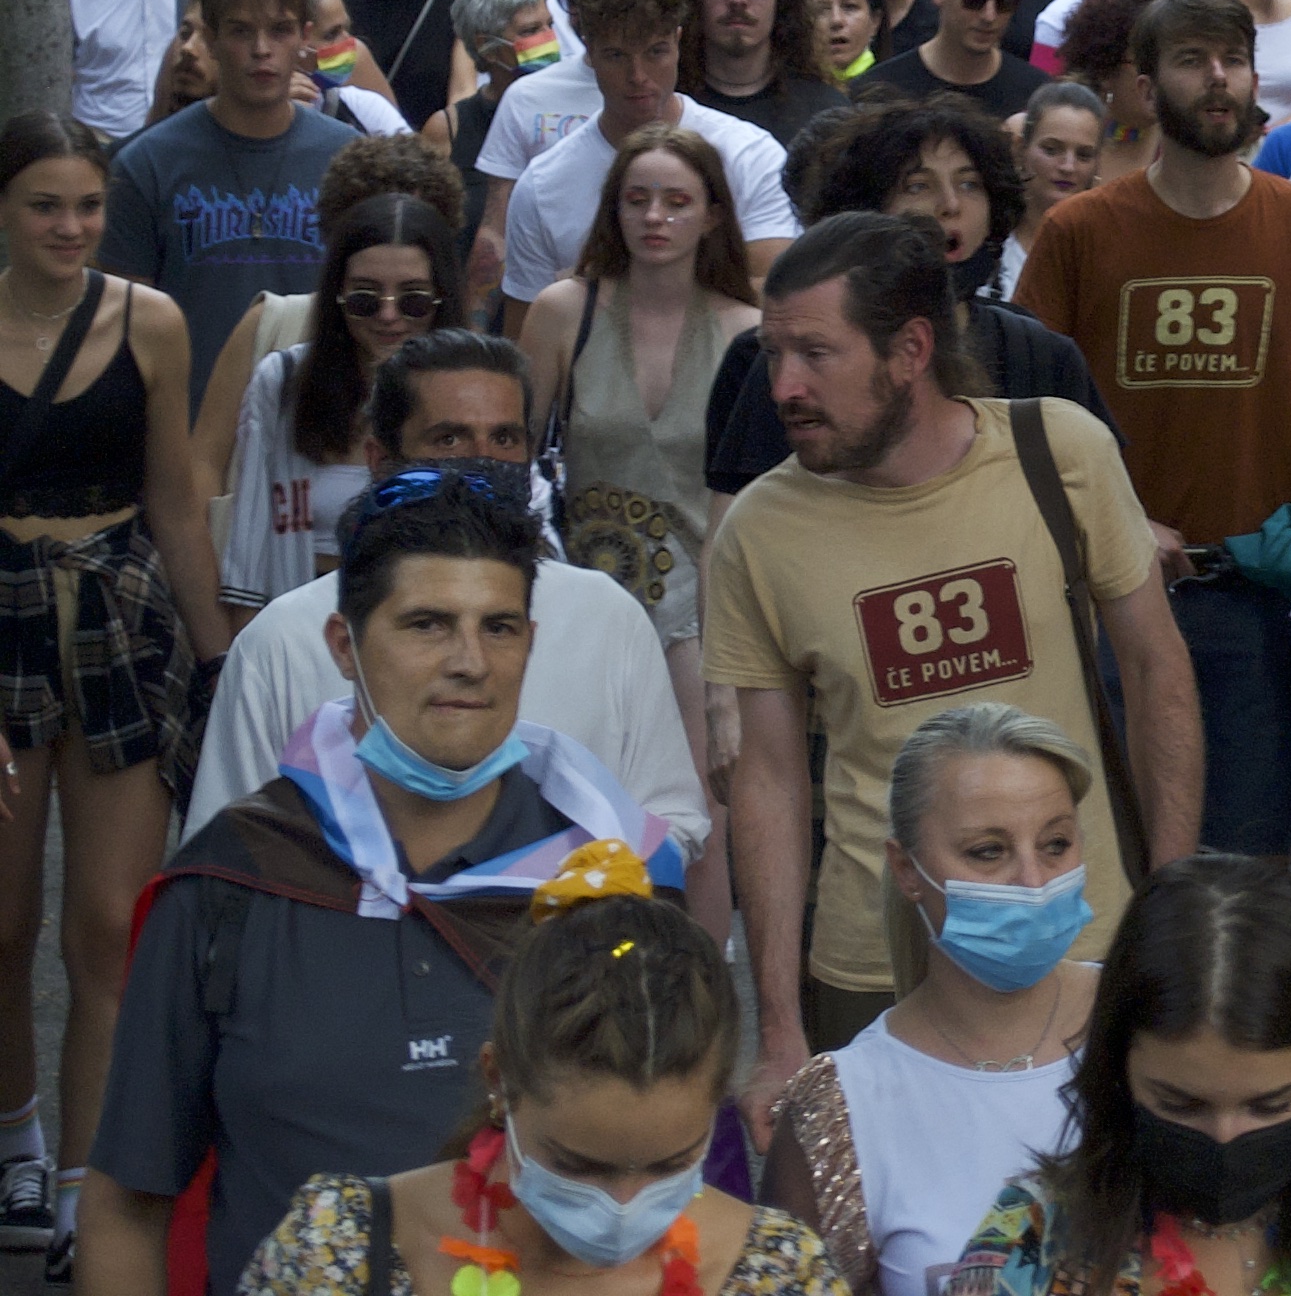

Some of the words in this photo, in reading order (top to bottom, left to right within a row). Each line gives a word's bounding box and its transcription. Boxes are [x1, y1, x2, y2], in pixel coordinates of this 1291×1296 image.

[173, 184, 328, 261] THRSHE
[1155, 287, 1239, 346] 83
[1134, 351, 1157, 372] ČE
[893, 577, 991, 655] 83
[886, 666, 913, 690] ČE
[409, 1038, 447, 1060] HH
